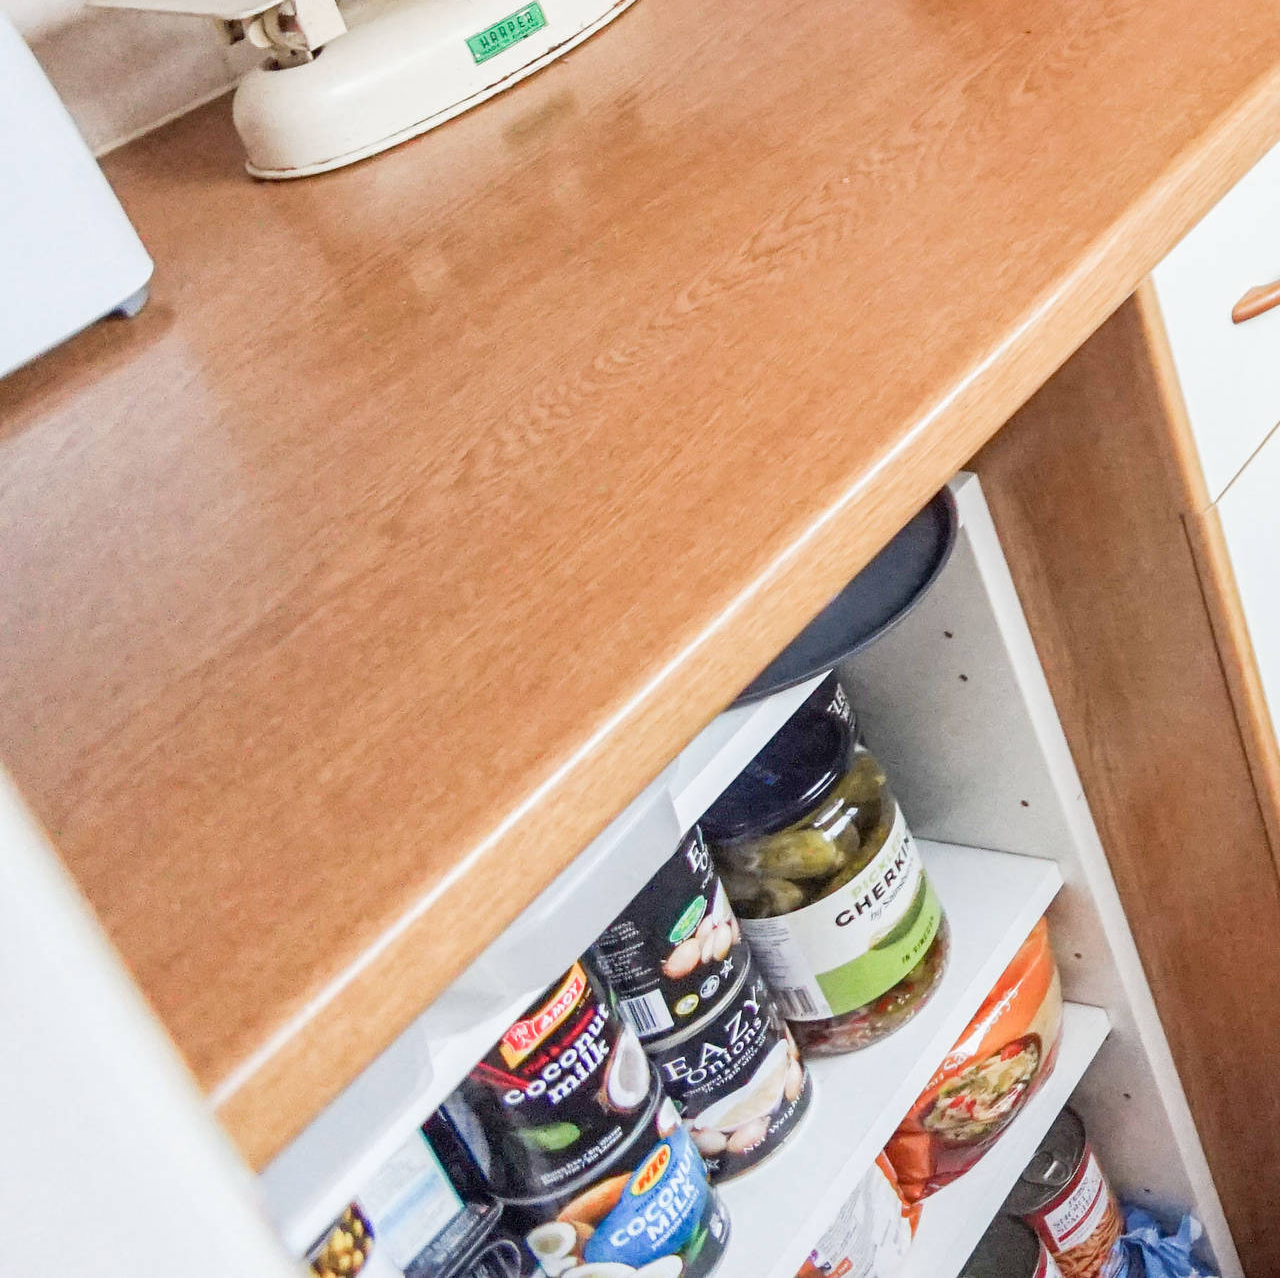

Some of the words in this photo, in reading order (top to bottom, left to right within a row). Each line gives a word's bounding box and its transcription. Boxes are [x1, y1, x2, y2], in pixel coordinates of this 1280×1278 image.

[480, 11, 534, 49] HARPER
[540, 983, 580, 1028] AMOY
[663, 986, 761, 1082] EAZY
[503, 1003, 610, 1106] coconut
[546, 1039, 611, 1105] milk
[687, 1017, 763, 1084] Onions
[646, 1179, 695, 1241] MILK
